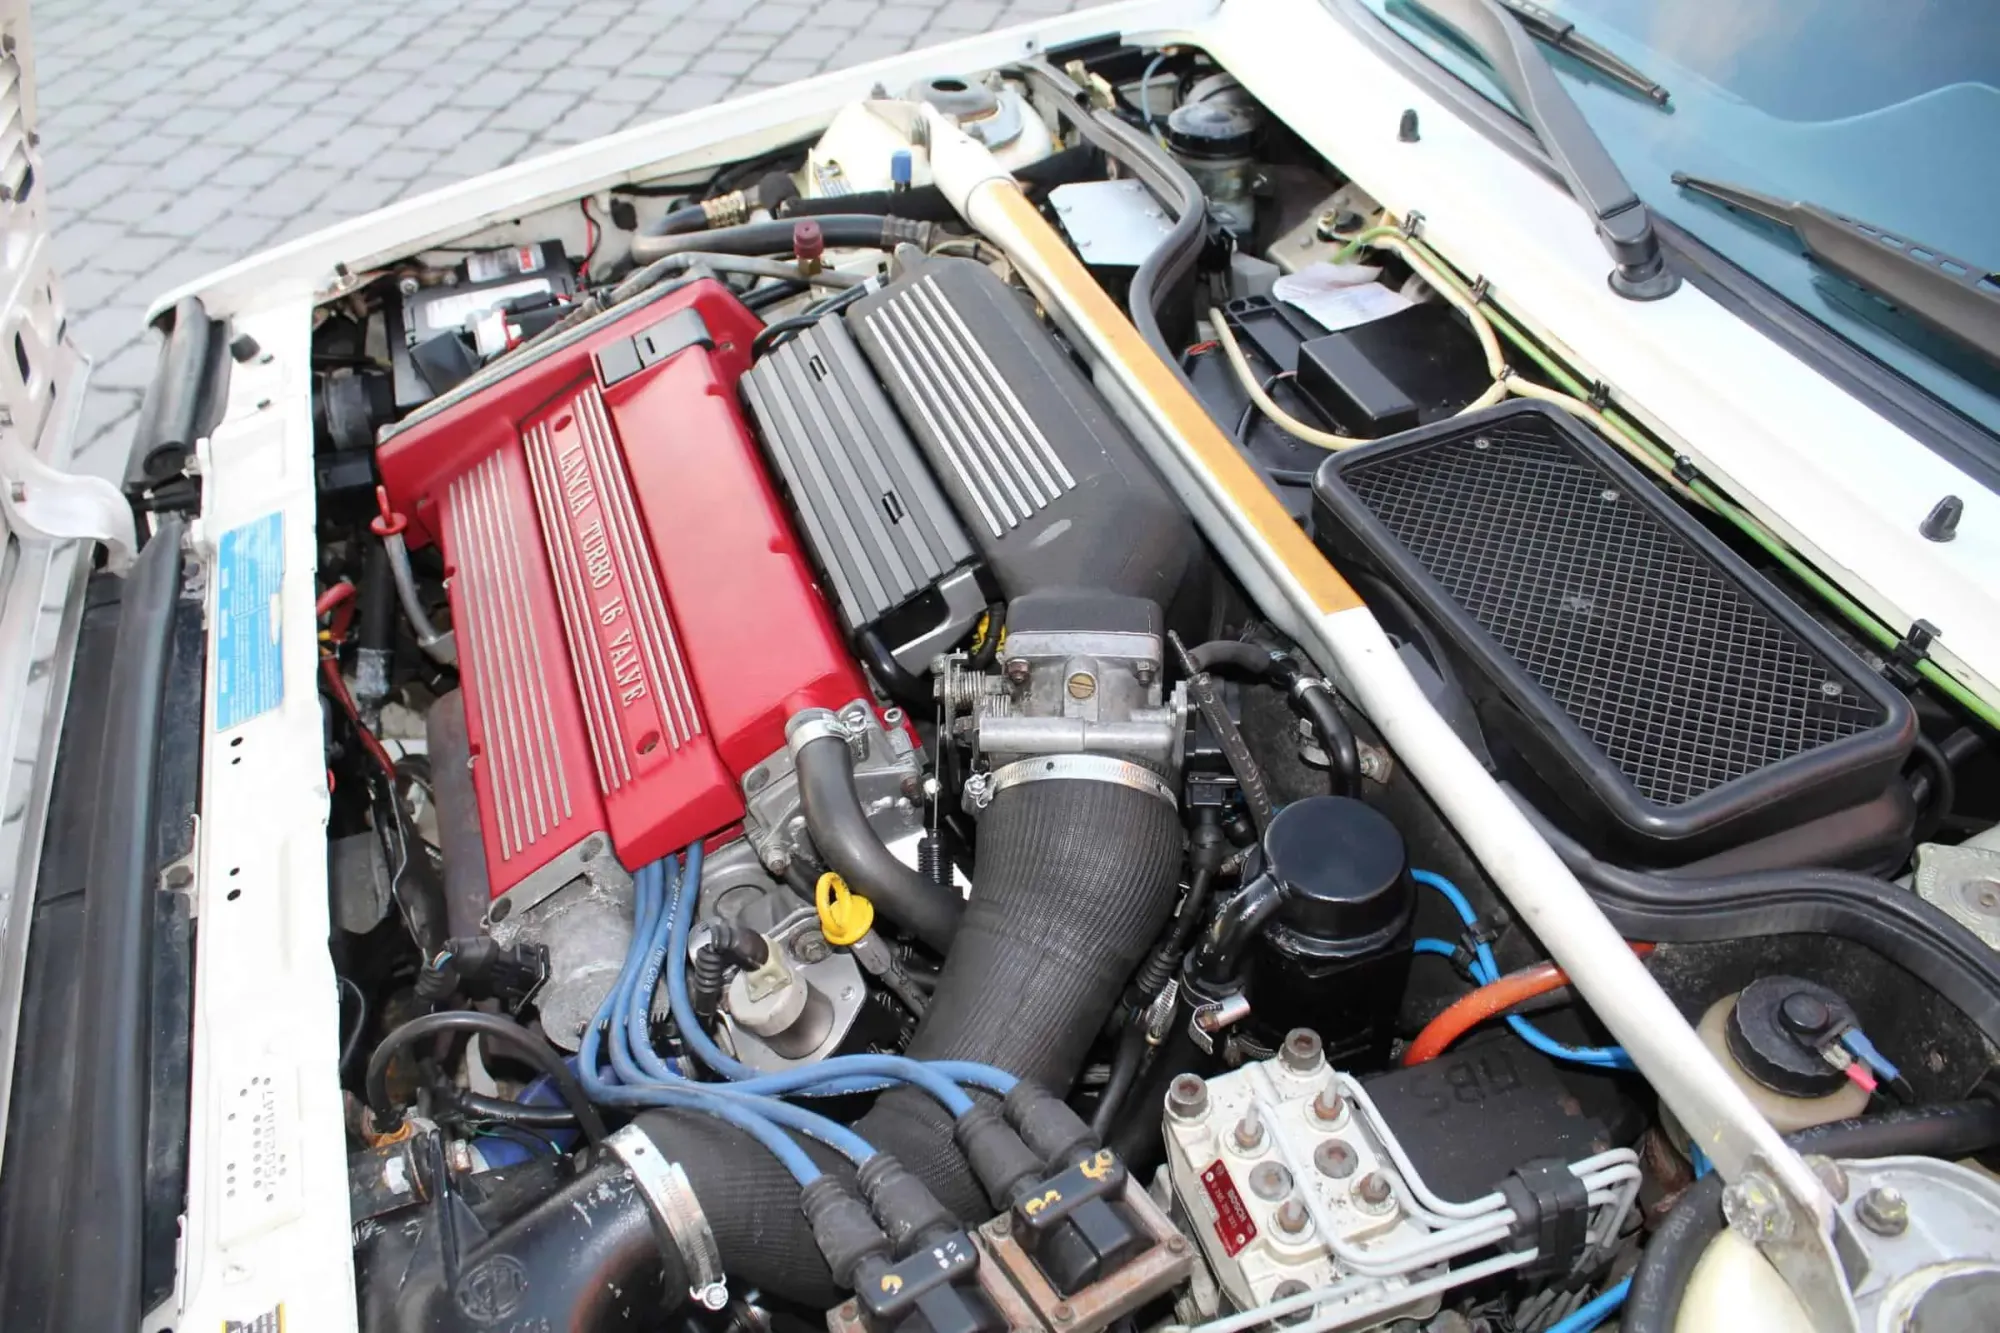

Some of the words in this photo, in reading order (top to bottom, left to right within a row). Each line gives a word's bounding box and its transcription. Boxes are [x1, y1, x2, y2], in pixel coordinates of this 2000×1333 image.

[559, 444, 596, 517] LANCIA
[581, 520, 614, 590] TURBO
[599, 596, 624, 626] 16
[609, 628, 647, 707] VALVE
